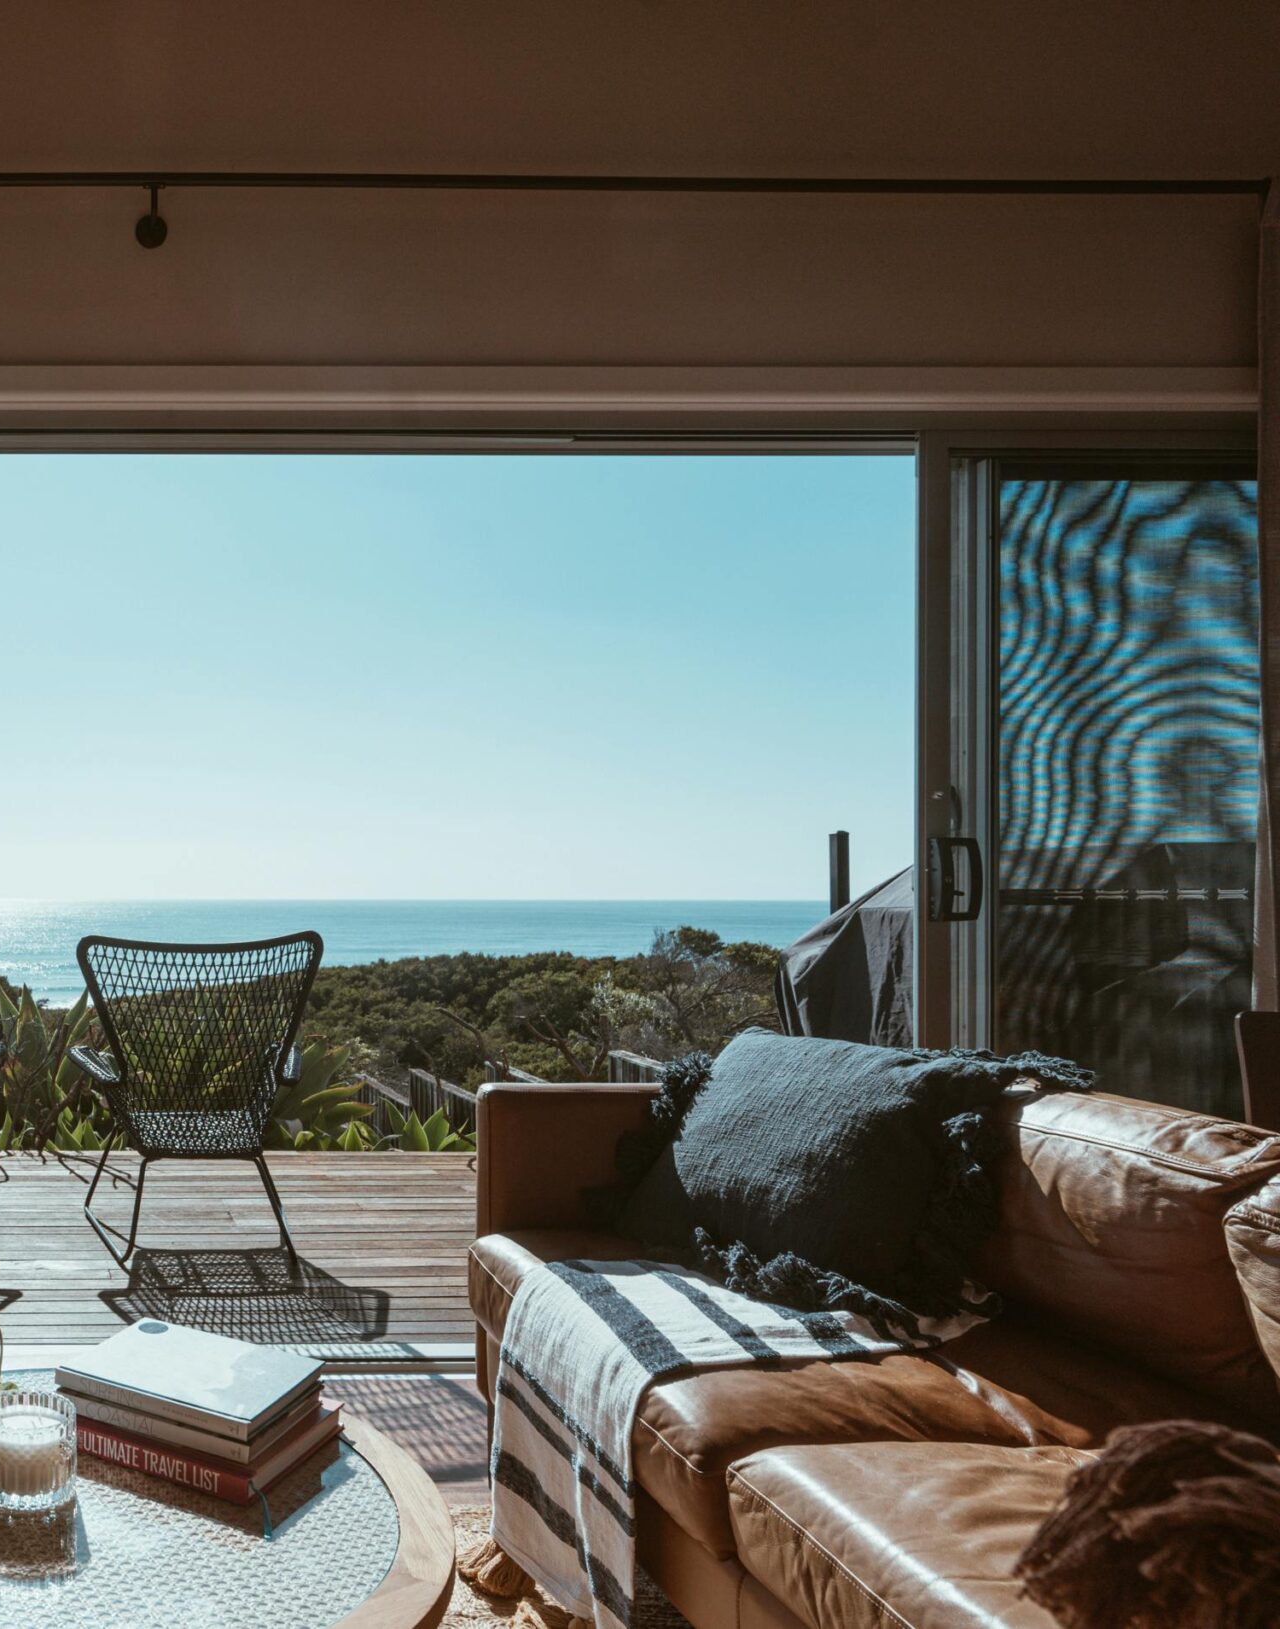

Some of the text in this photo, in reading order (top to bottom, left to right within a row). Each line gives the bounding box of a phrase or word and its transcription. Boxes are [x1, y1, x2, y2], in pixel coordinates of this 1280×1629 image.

[80, 1378, 142, 1408] SURFING
[83, 1430, 140, 1467] ULTIMATE
[142, 1449, 191, 1484] TRAVEL
[192, 1465, 220, 1493] LIST
